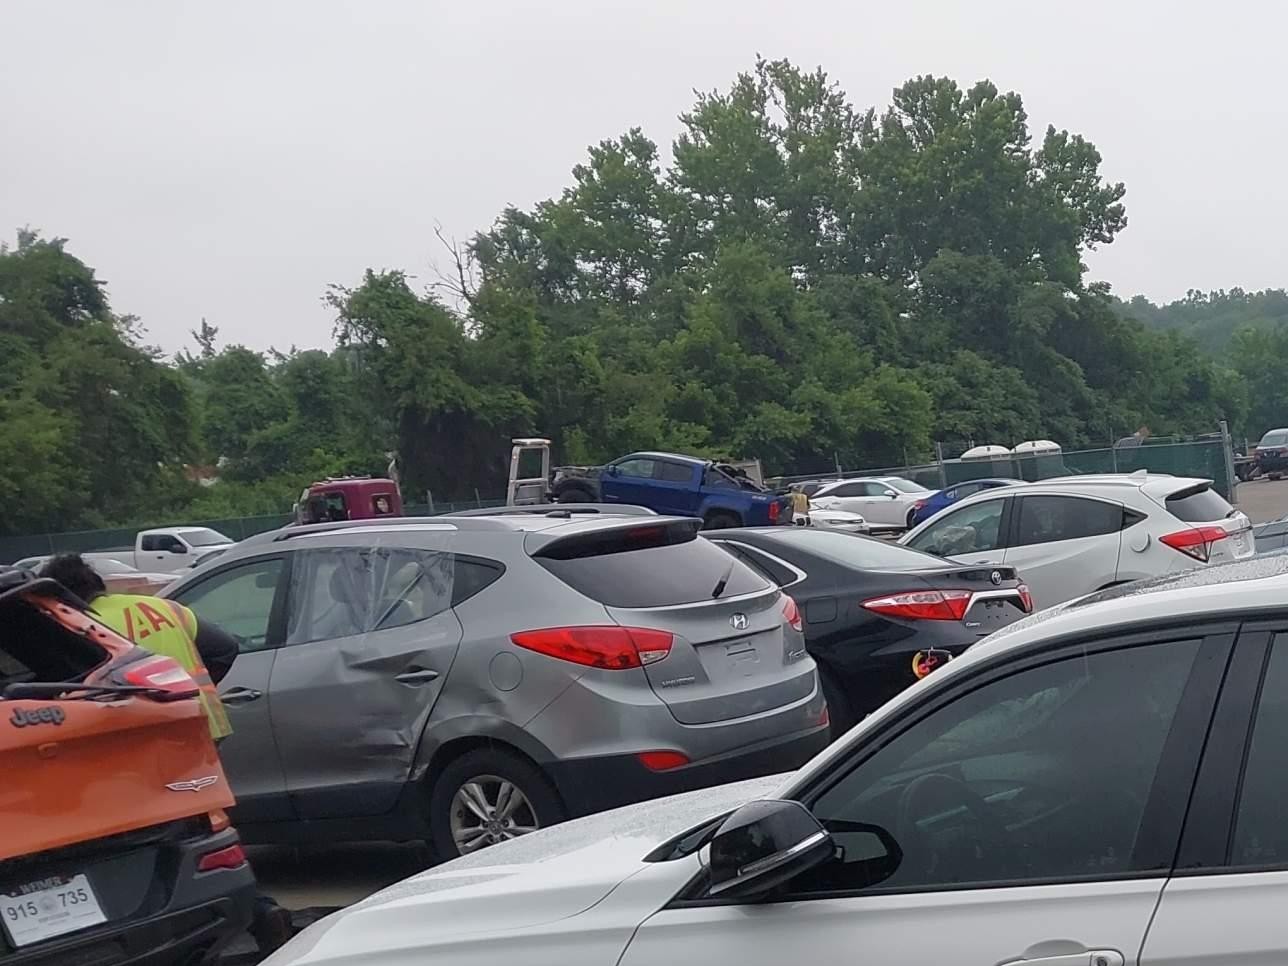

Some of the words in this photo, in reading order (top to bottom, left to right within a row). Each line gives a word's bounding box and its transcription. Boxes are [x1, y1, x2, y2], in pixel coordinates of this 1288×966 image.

[9, 706, 65, 728] Jeep
[7, 901, 38, 921] 915
[57, 888, 88, 907] 735
